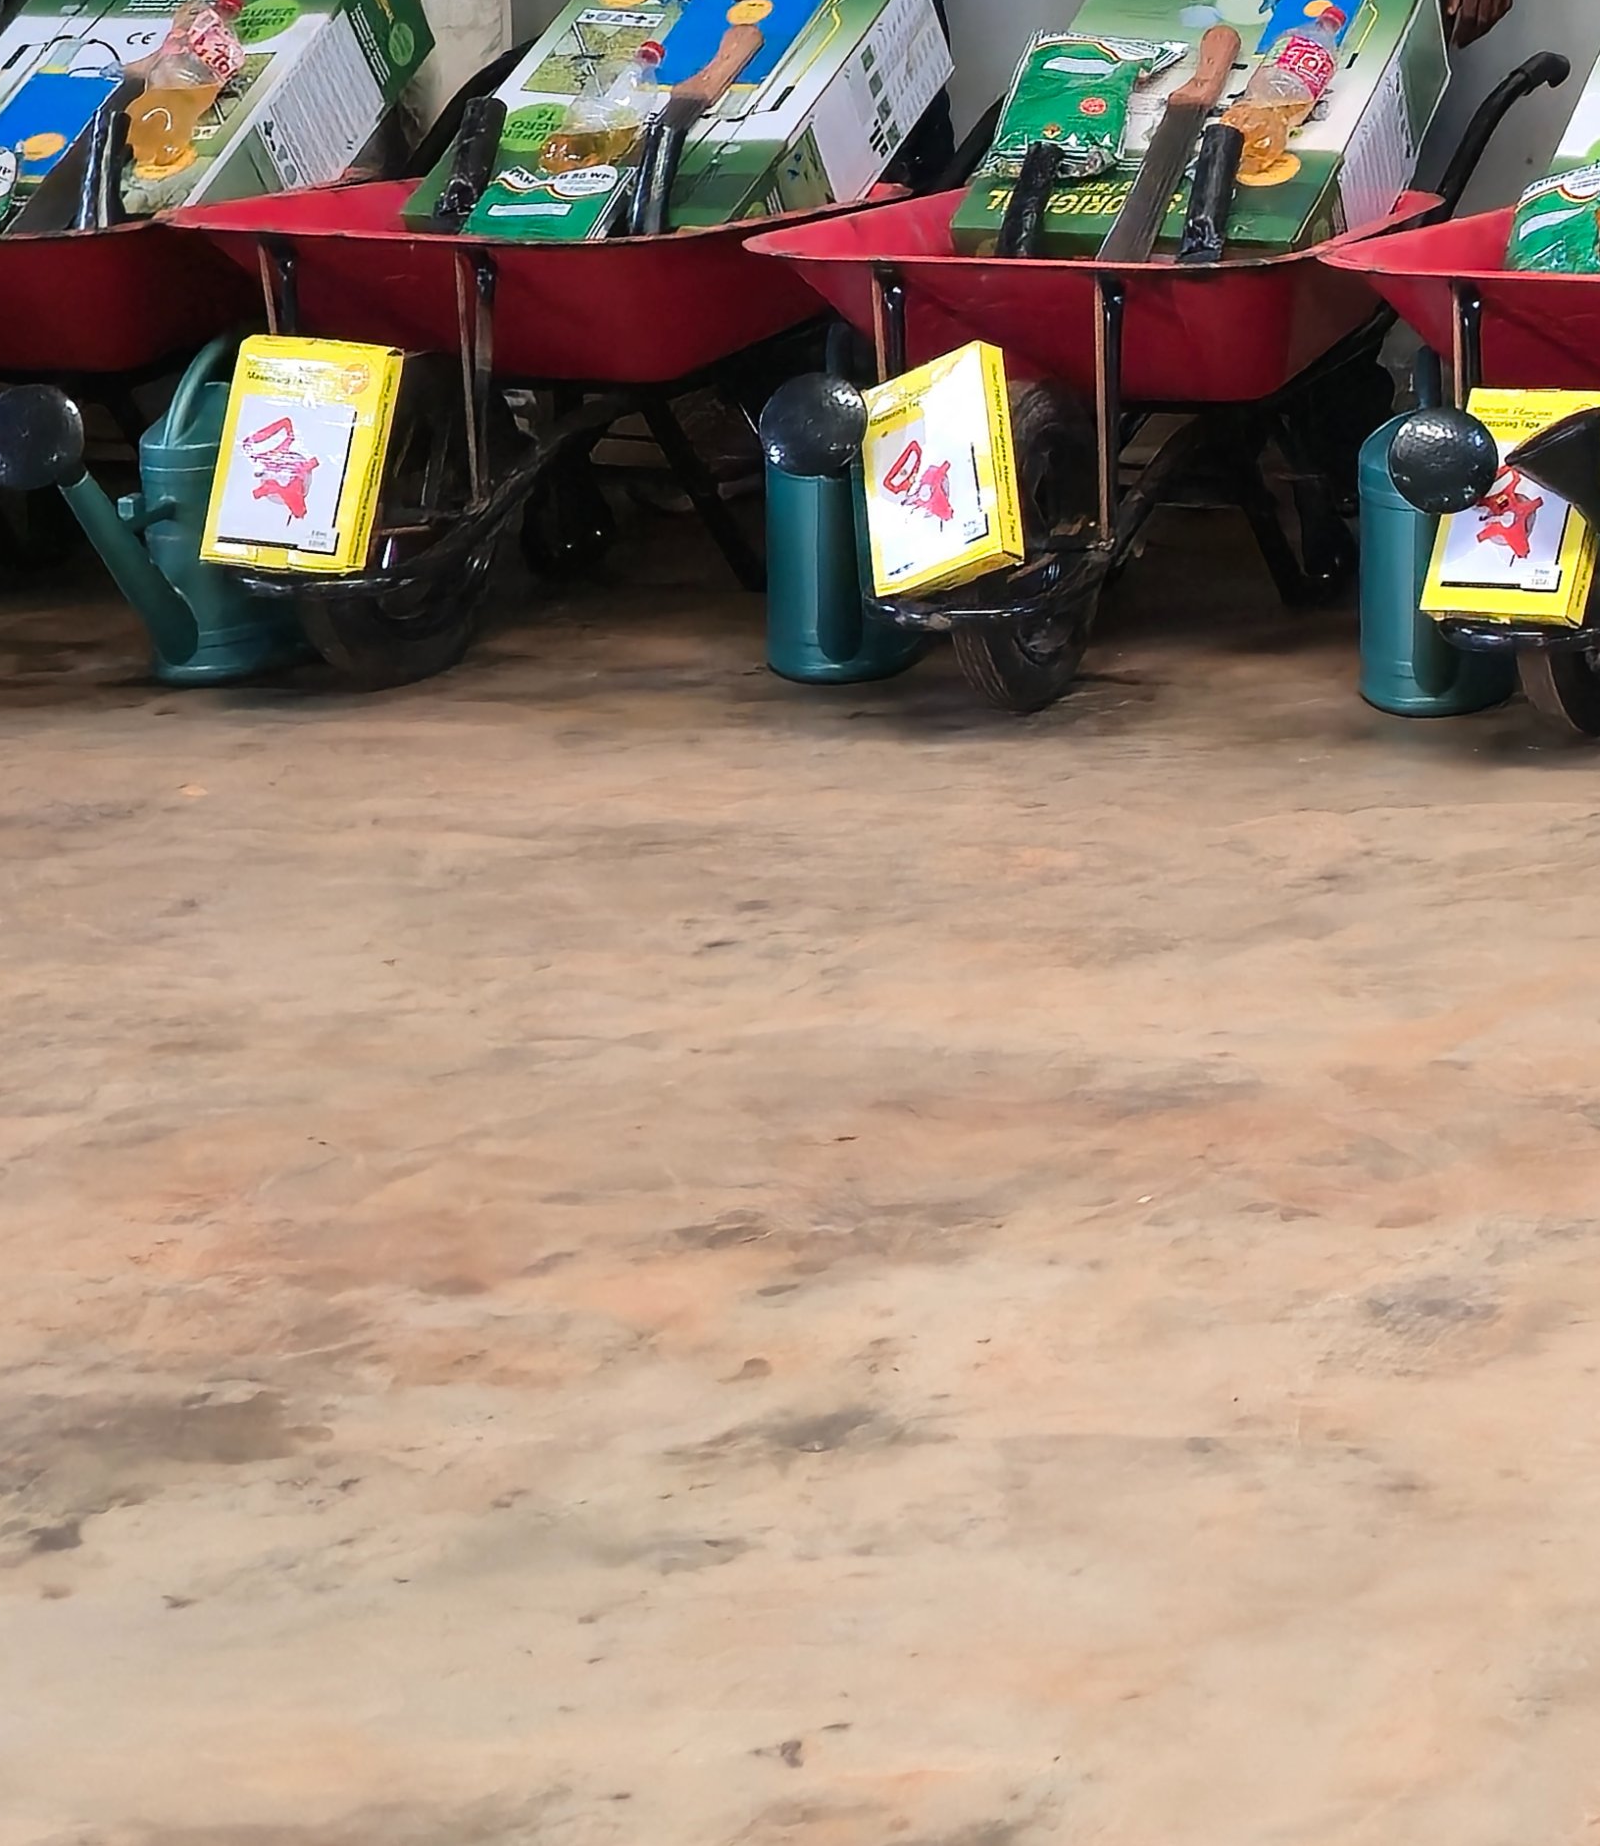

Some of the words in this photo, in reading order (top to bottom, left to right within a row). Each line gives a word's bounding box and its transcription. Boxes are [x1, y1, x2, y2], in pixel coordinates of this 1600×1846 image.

[126, 32, 157, 45] CE
[501, 129, 548, 142] UPER
[986, 190, 1128, 216] ORIGL
[1481, 419, 1518, 429] easuring
